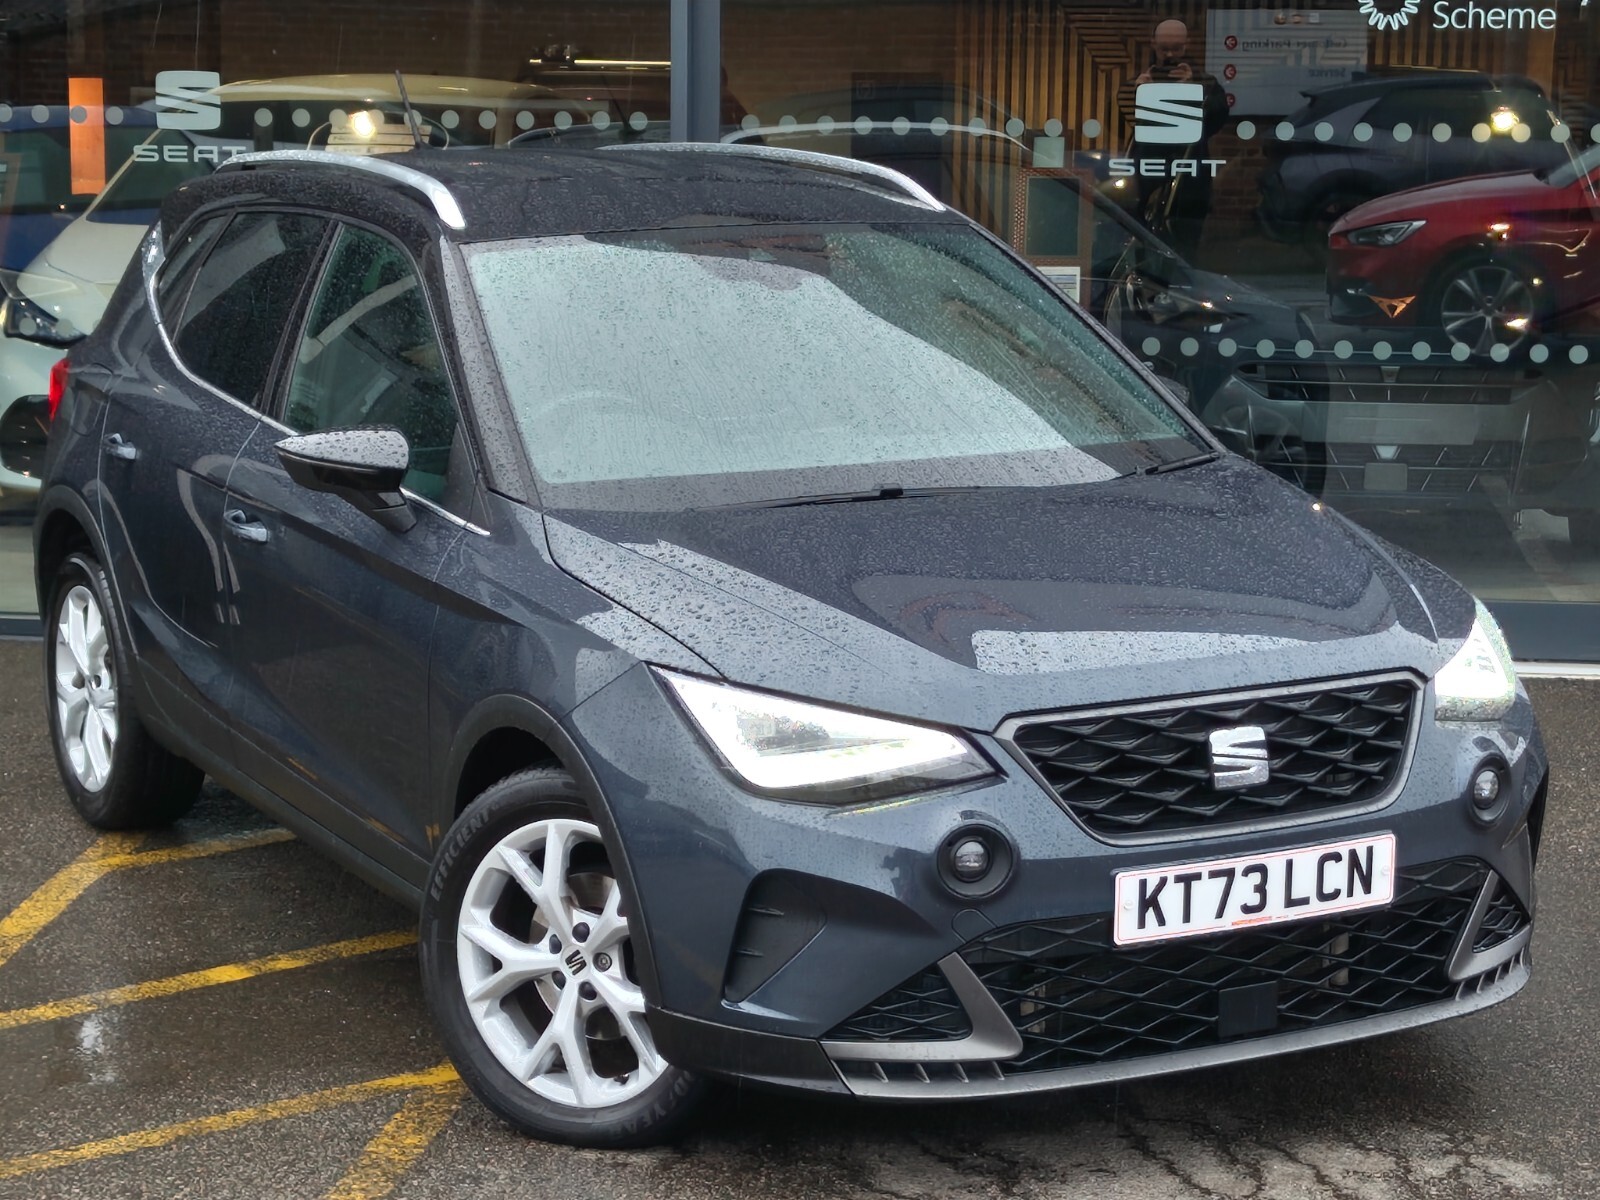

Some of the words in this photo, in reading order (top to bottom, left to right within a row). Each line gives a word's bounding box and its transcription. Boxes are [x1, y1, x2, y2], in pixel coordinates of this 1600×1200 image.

[1432, 1, 1556, 29] Scheme
[133, 145, 246, 163] SEAT
[1108, 158, 1226, 177] SEAT
[430, 808, 490, 902] EFFICIENT
[1137, 863, 1268, 930] KT73
[1283, 845, 1374, 909] LCN
